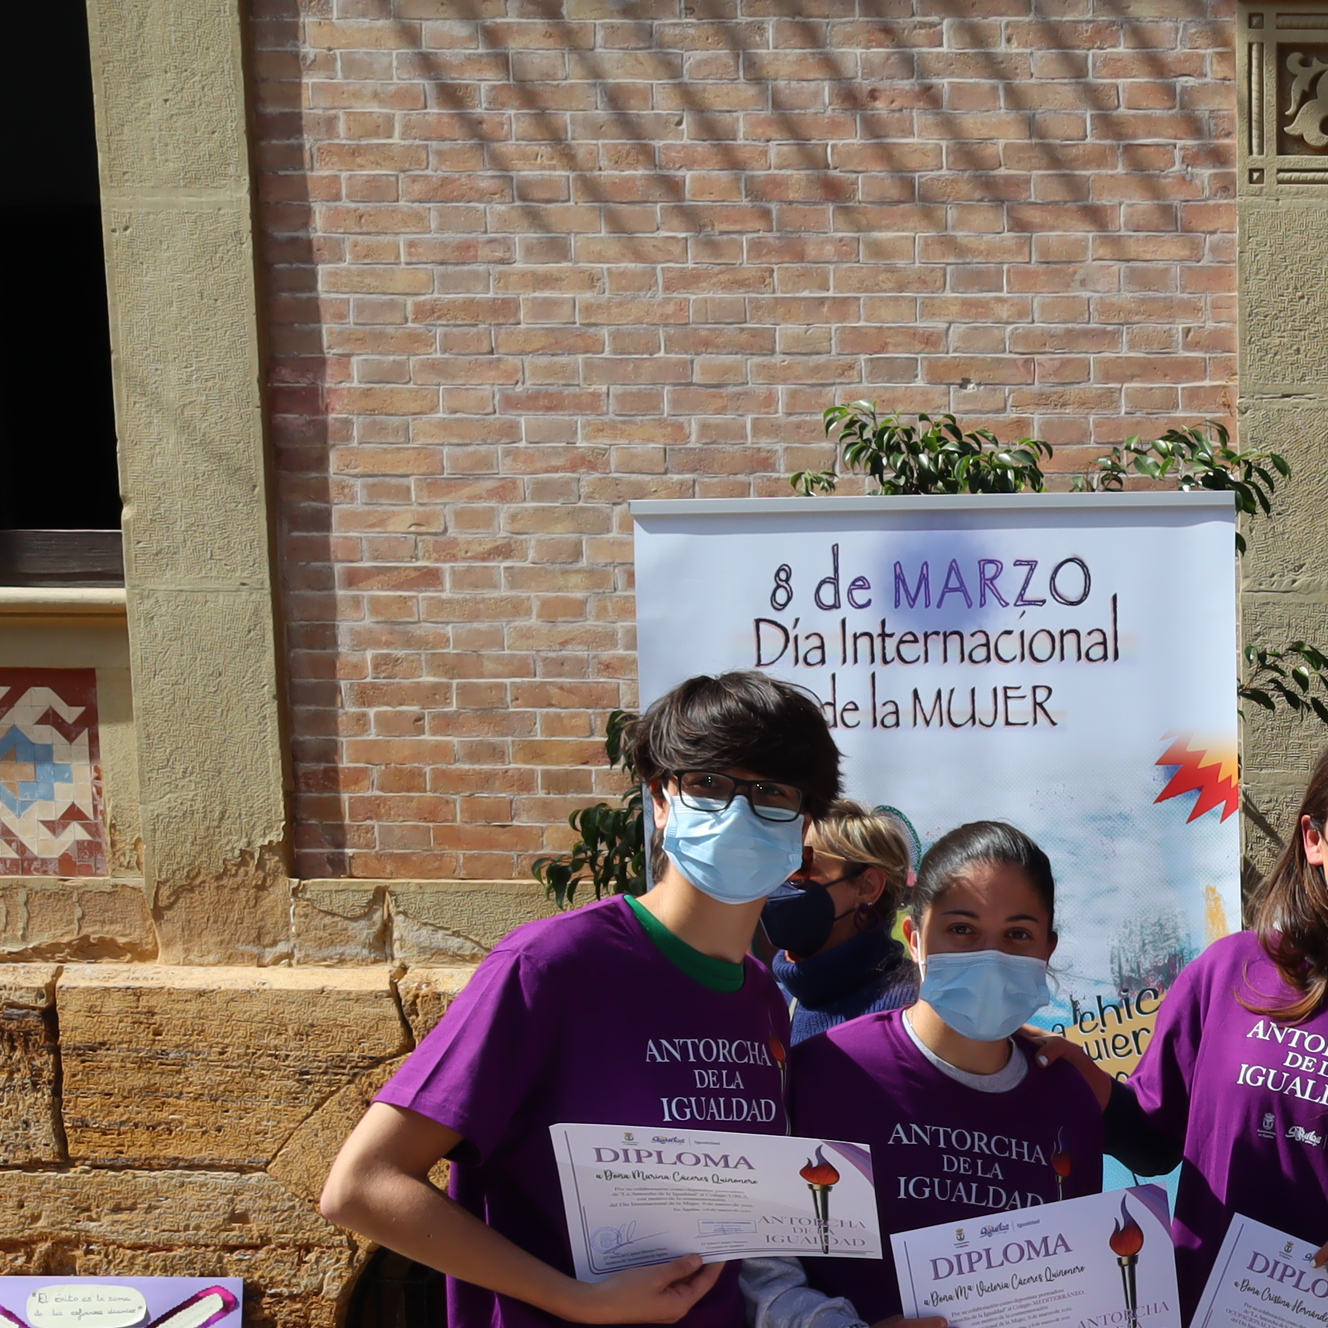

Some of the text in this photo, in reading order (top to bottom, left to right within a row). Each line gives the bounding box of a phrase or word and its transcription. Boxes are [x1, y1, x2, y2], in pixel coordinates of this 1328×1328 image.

[770, 543, 1091, 610] 8 de MARZO
[753, 593, 1118, 668] Día Internacional
[871, 672, 901, 728] la
[912, 685, 1058, 728] MUJER
[1079, 988, 1160, 1034] chic
[645, 1038, 772, 1067] ANTORCHA
[1283, 1052, 1317, 1073] DE
[694, 1069, 744, 1090] DE LA
[660, 1098, 777, 1123] IGUALDAD
[888, 1123, 1047, 1166] ANTORCHA
[592, 1147, 756, 1170] DIPLOMA
[942, 1155, 1004, 1180] DE LA
[897, 1176, 1043, 1211] IGUALDAD
[758, 1215, 866, 1230] ANTORCHA
[792, 1226, 812, 1234] DE
[765, 1234, 866, 1246] IGUALDAD
[930, 1232, 1073, 1281] DIPLOMA
[976, 1280, 1010, 1297] Victoria
[1261, 1287, 1291, 1309] Cristina
